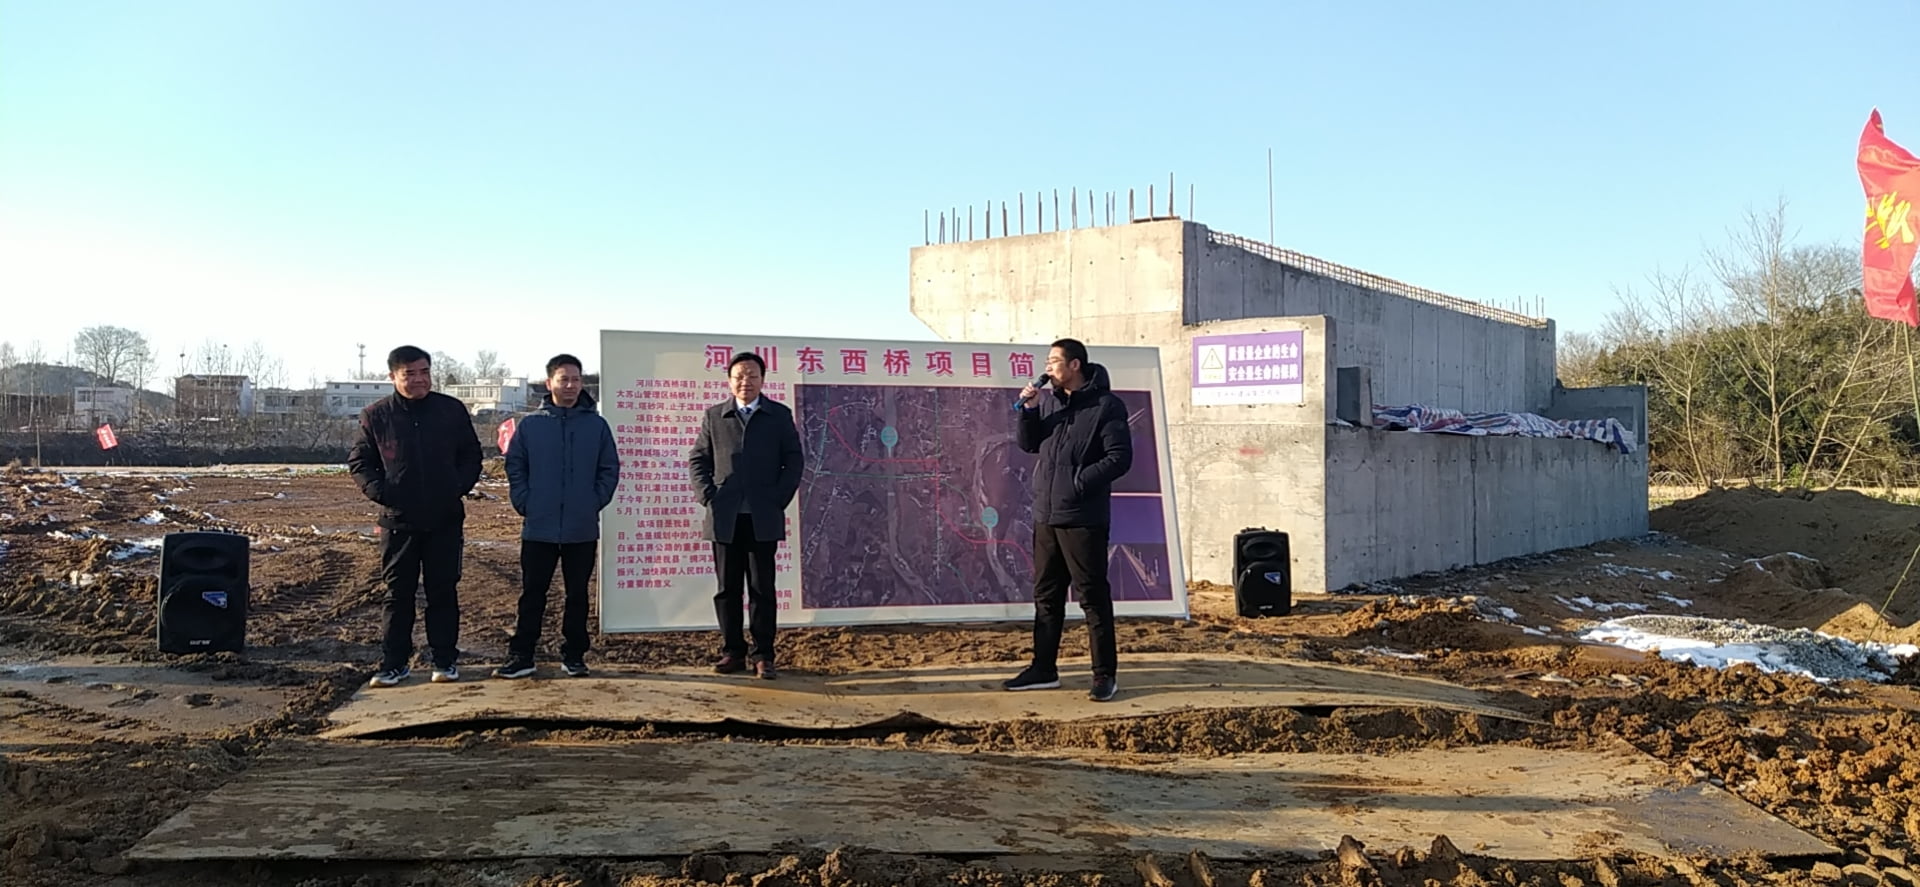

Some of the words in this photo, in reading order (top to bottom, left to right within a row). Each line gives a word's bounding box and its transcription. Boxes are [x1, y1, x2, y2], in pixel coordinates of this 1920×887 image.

[704, 344, 1034, 378] 河川东西桥项目简
[636, 414, 671, 423] 项目全长
[676, 415, 697, 423] 3.924
[637, 519, 704, 528] 该项目是我县“
[775, 552, 792, 561] 乡村
[617, 566, 715, 577] 振兴，加快两岸人民群众
[776, 563, 792, 572] 有十
